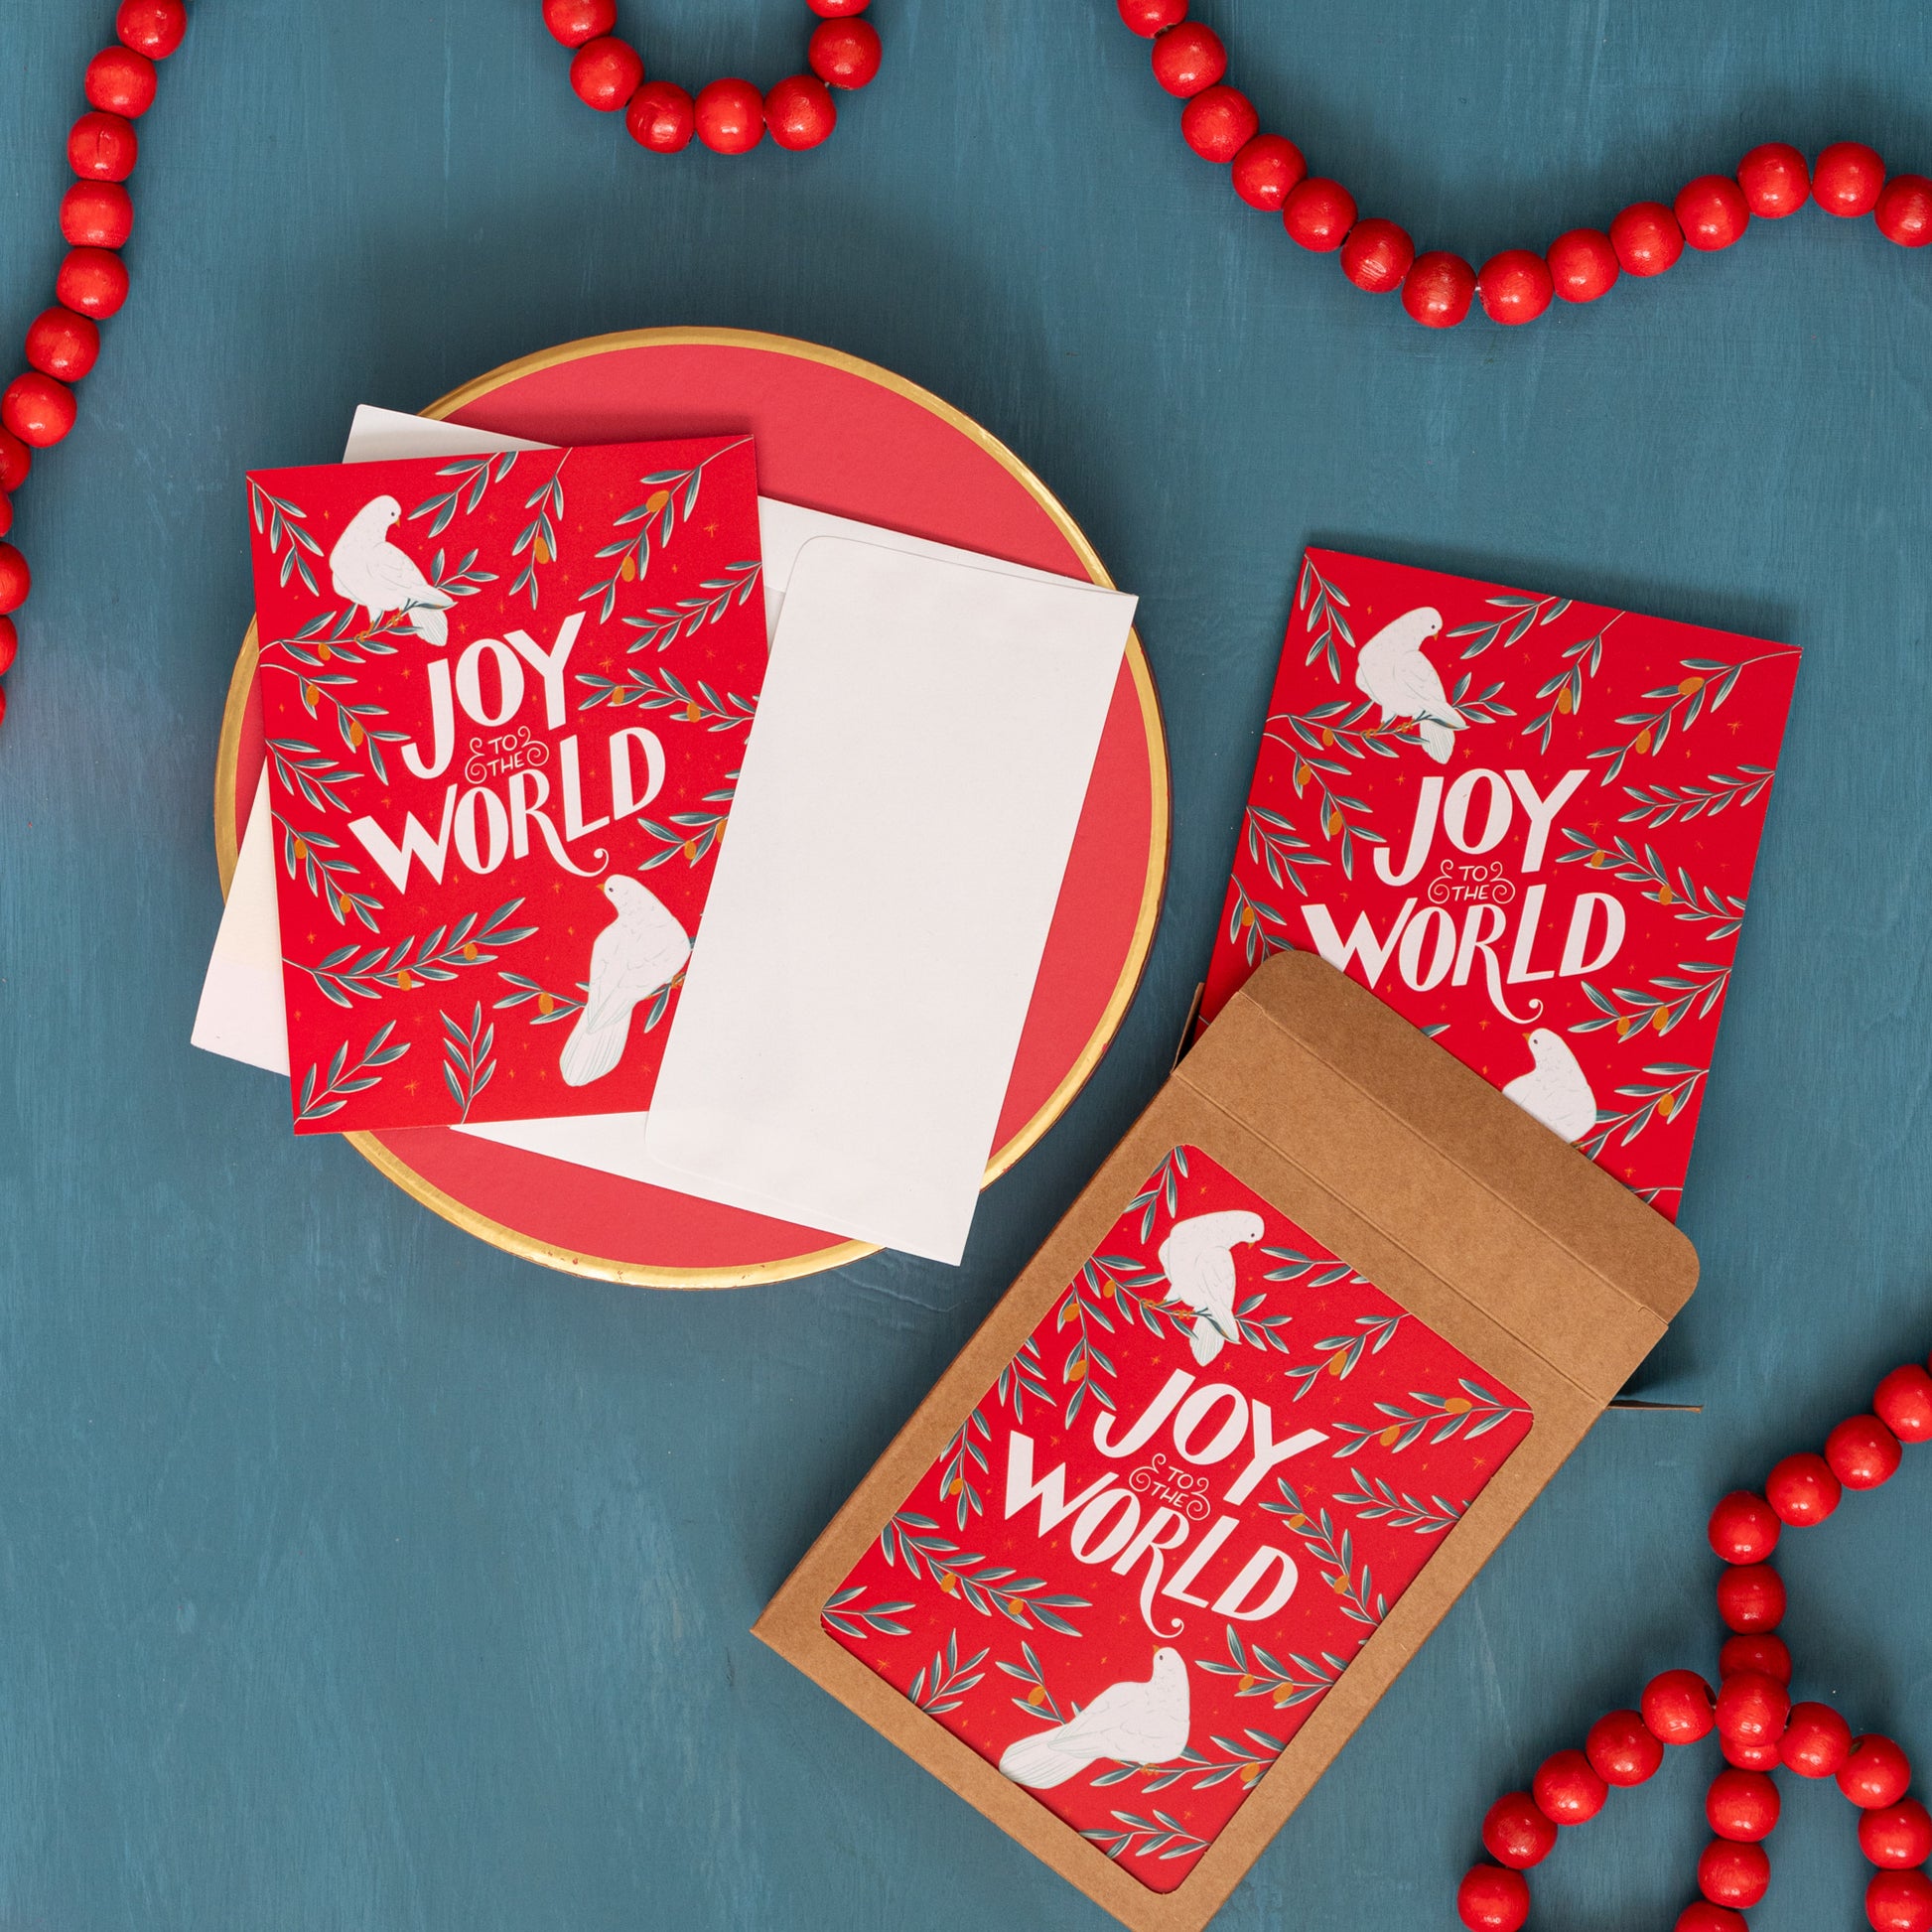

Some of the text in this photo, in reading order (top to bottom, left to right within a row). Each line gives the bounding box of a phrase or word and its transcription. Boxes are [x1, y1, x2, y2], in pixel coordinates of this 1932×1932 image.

[401, 611, 586, 779] JOY
[486, 752, 524, 776] THE
[487, 734, 518, 755] TO
[347, 727, 665, 895] WORLD
[1373, 767, 1590, 887] JOY
[1451, 885, 1489, 900] THE
[1458, 865, 1488, 882] TO
[1301, 884, 1626, 1024] WORLD
[1093, 1368, 1330, 1506] JOY
[1152, 1481, 1188, 1508] THE
[1168, 1465, 1193, 1489] TO
[1005, 1430, 1299, 1638] WORLD
